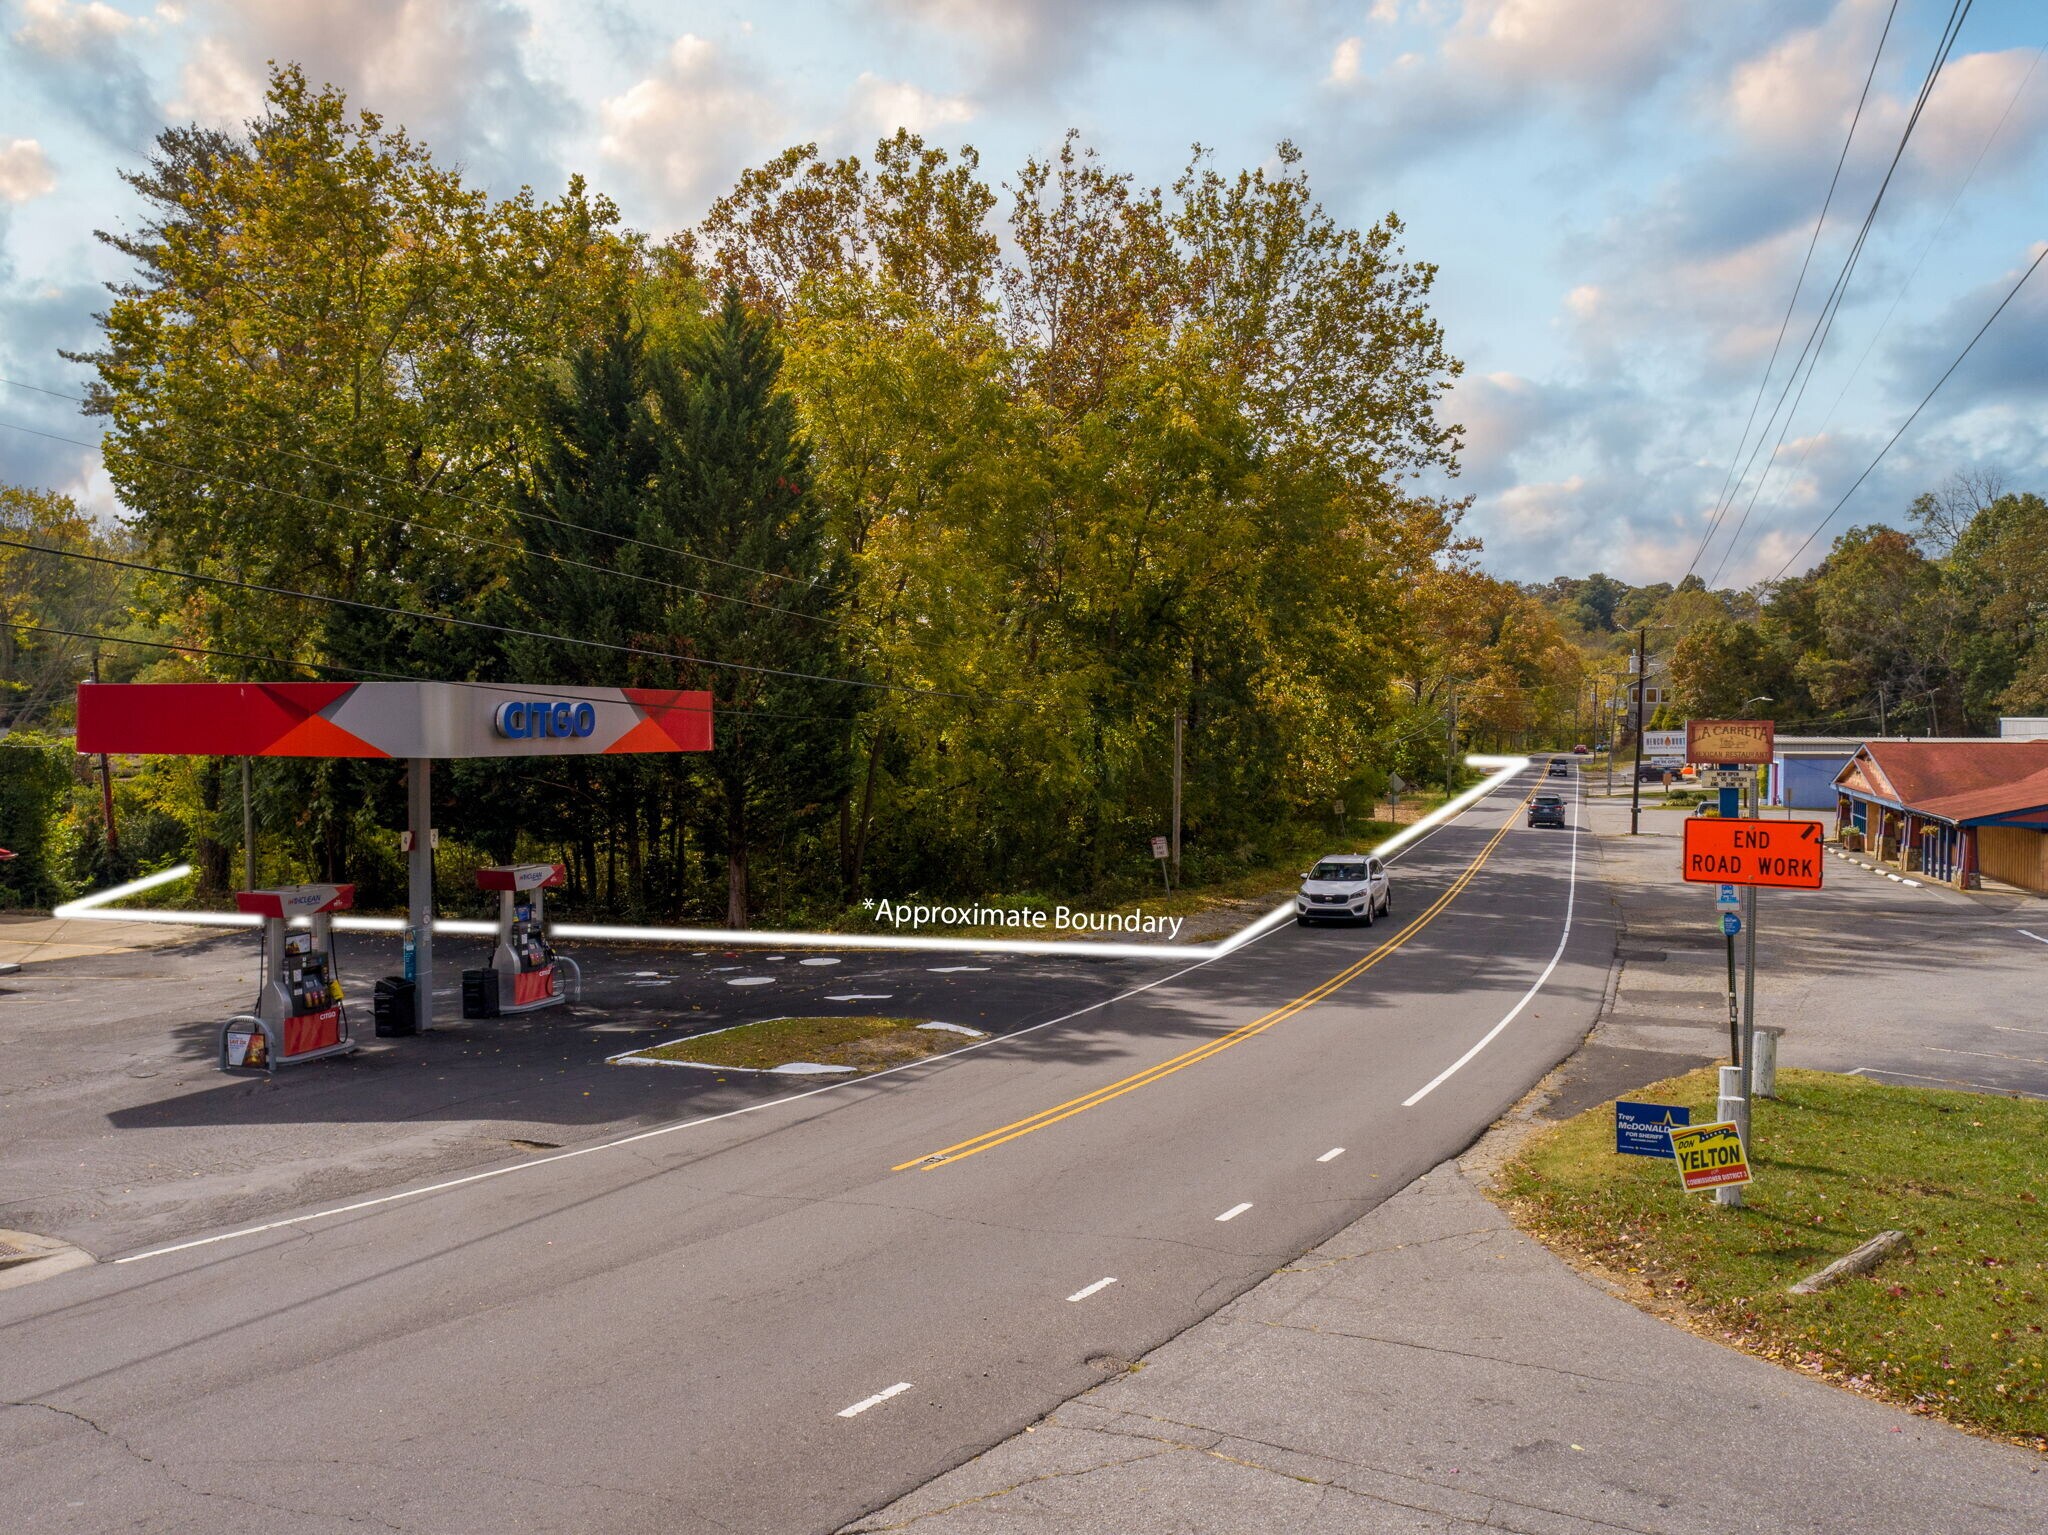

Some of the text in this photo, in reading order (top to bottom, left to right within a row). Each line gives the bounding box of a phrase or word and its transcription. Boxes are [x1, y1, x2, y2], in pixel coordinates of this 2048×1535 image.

[497, 701, 595, 739] CITGO
[1691, 726, 1769, 742] LA CARRETA
[1694, 751, 1769, 759] MEXICAN RESTAURANT
[403, 836, 408, 845] 4
[431, 833, 437, 843] 2
[1734, 830, 1770, 849] END
[1692, 854, 1813, 877] ROAD WORK
[320, 1011, 336, 1020] CITGO
[1618, 1113, 1635, 1122] Trey
[1618, 1121, 1671, 1133] McDONALD
[1638, 1132, 1664, 1140] SHERIFF
[1678, 1140, 1695, 1149] DON
[1679, 1144, 1740, 1171] YELTON
[1687, 1174, 1722, 1186] COMMISSIONER
[1721, 1171, 1743, 1181] DISTRICT
